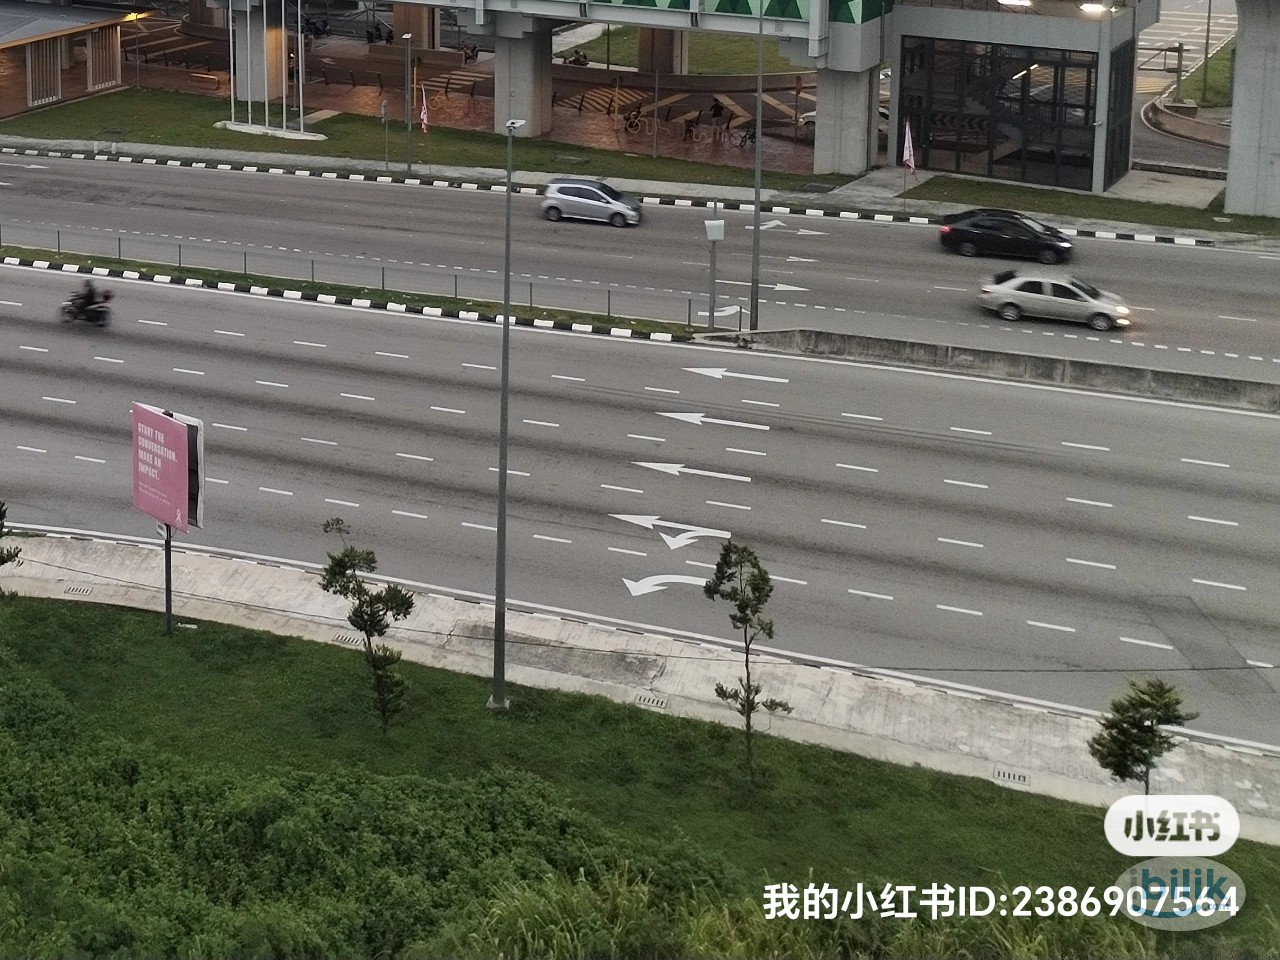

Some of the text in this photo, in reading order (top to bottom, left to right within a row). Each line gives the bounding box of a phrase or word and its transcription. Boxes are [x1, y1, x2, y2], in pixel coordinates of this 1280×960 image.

[137, 422, 165, 444] START THE
[138, 448, 162, 469] MAKE AN
[138, 461, 160, 481] IMPACT.
